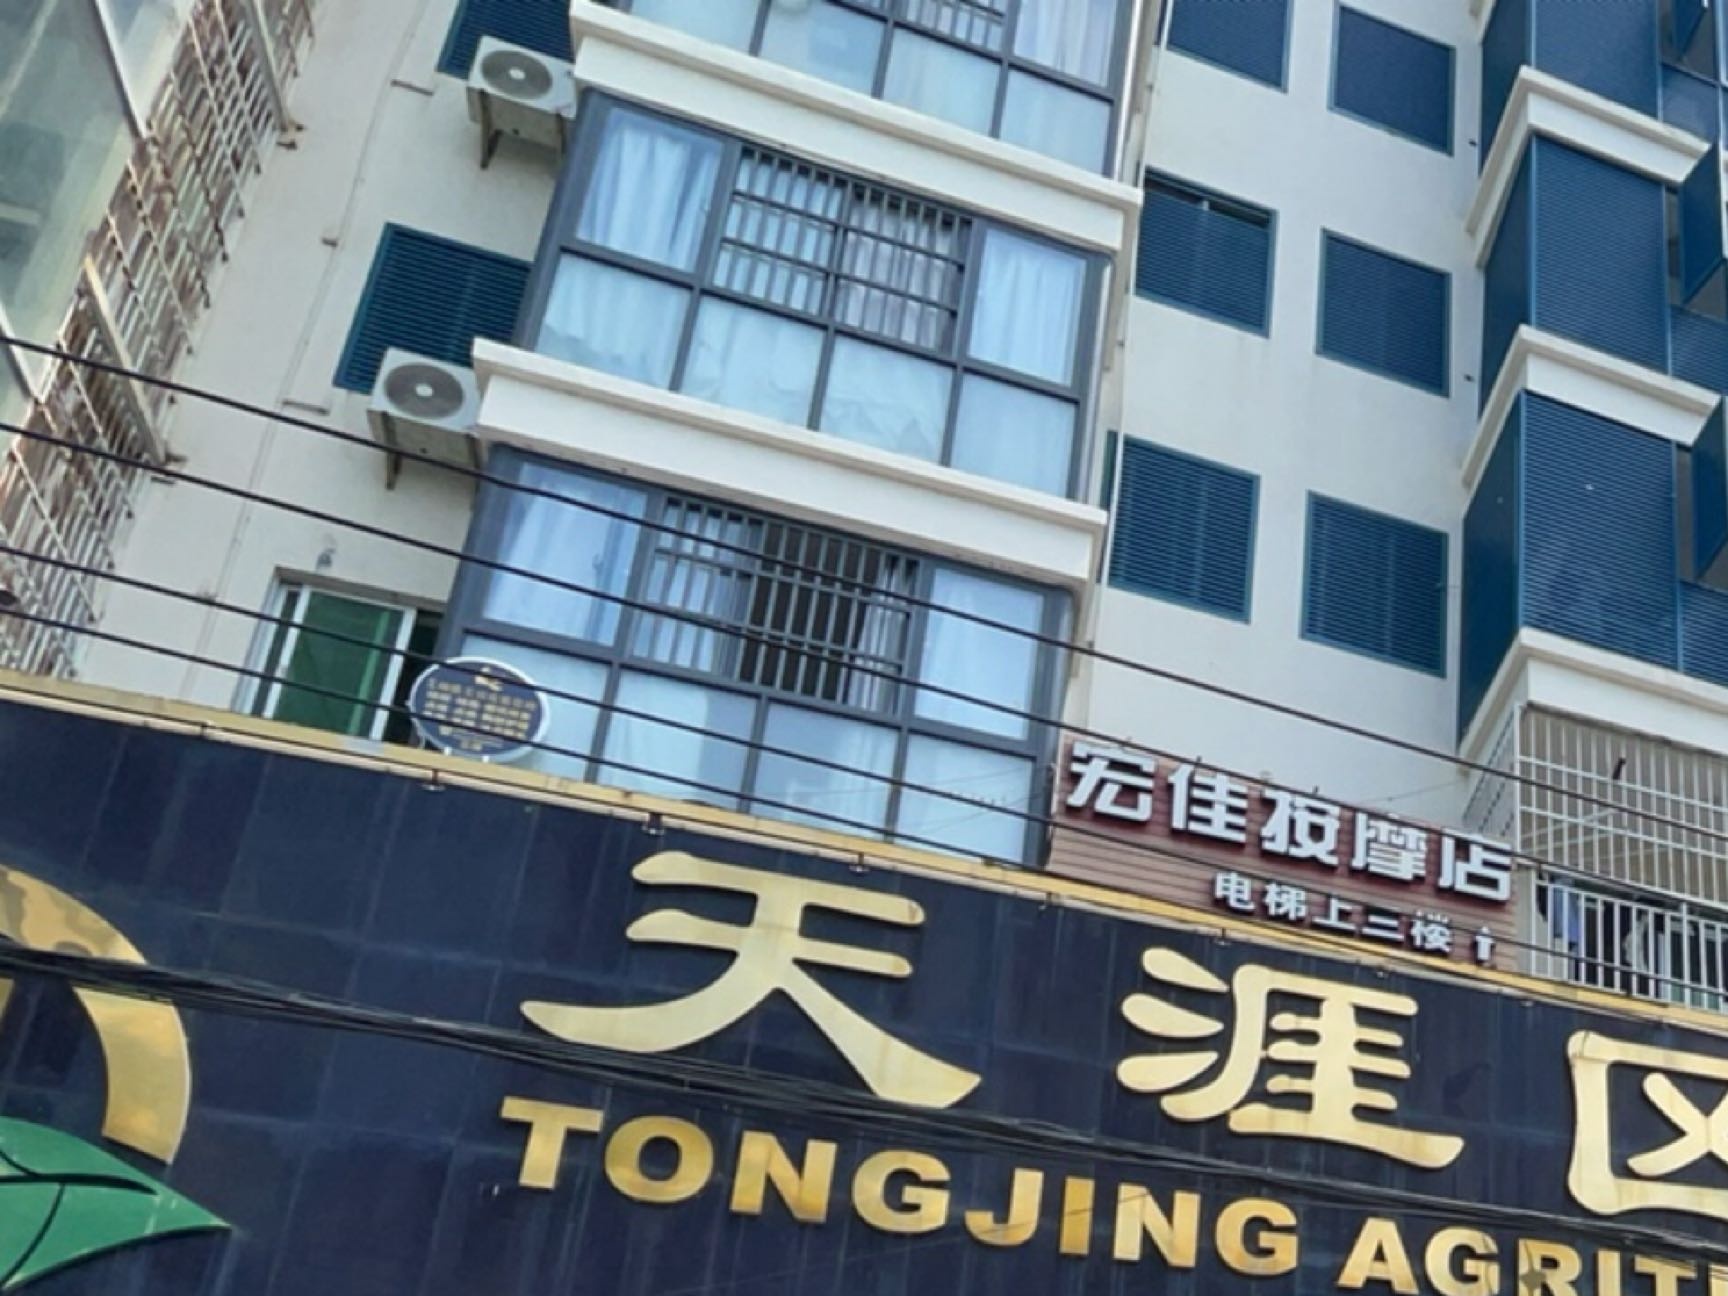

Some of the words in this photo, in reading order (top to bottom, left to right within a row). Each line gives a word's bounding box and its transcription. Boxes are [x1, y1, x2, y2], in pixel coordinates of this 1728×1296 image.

[1066, 741, 1512, 900] 宏佳按摩店
[1214, 872, 1453, 953] 电梯上三楼
[501, 1096, 1299, 1276] TONGJING
